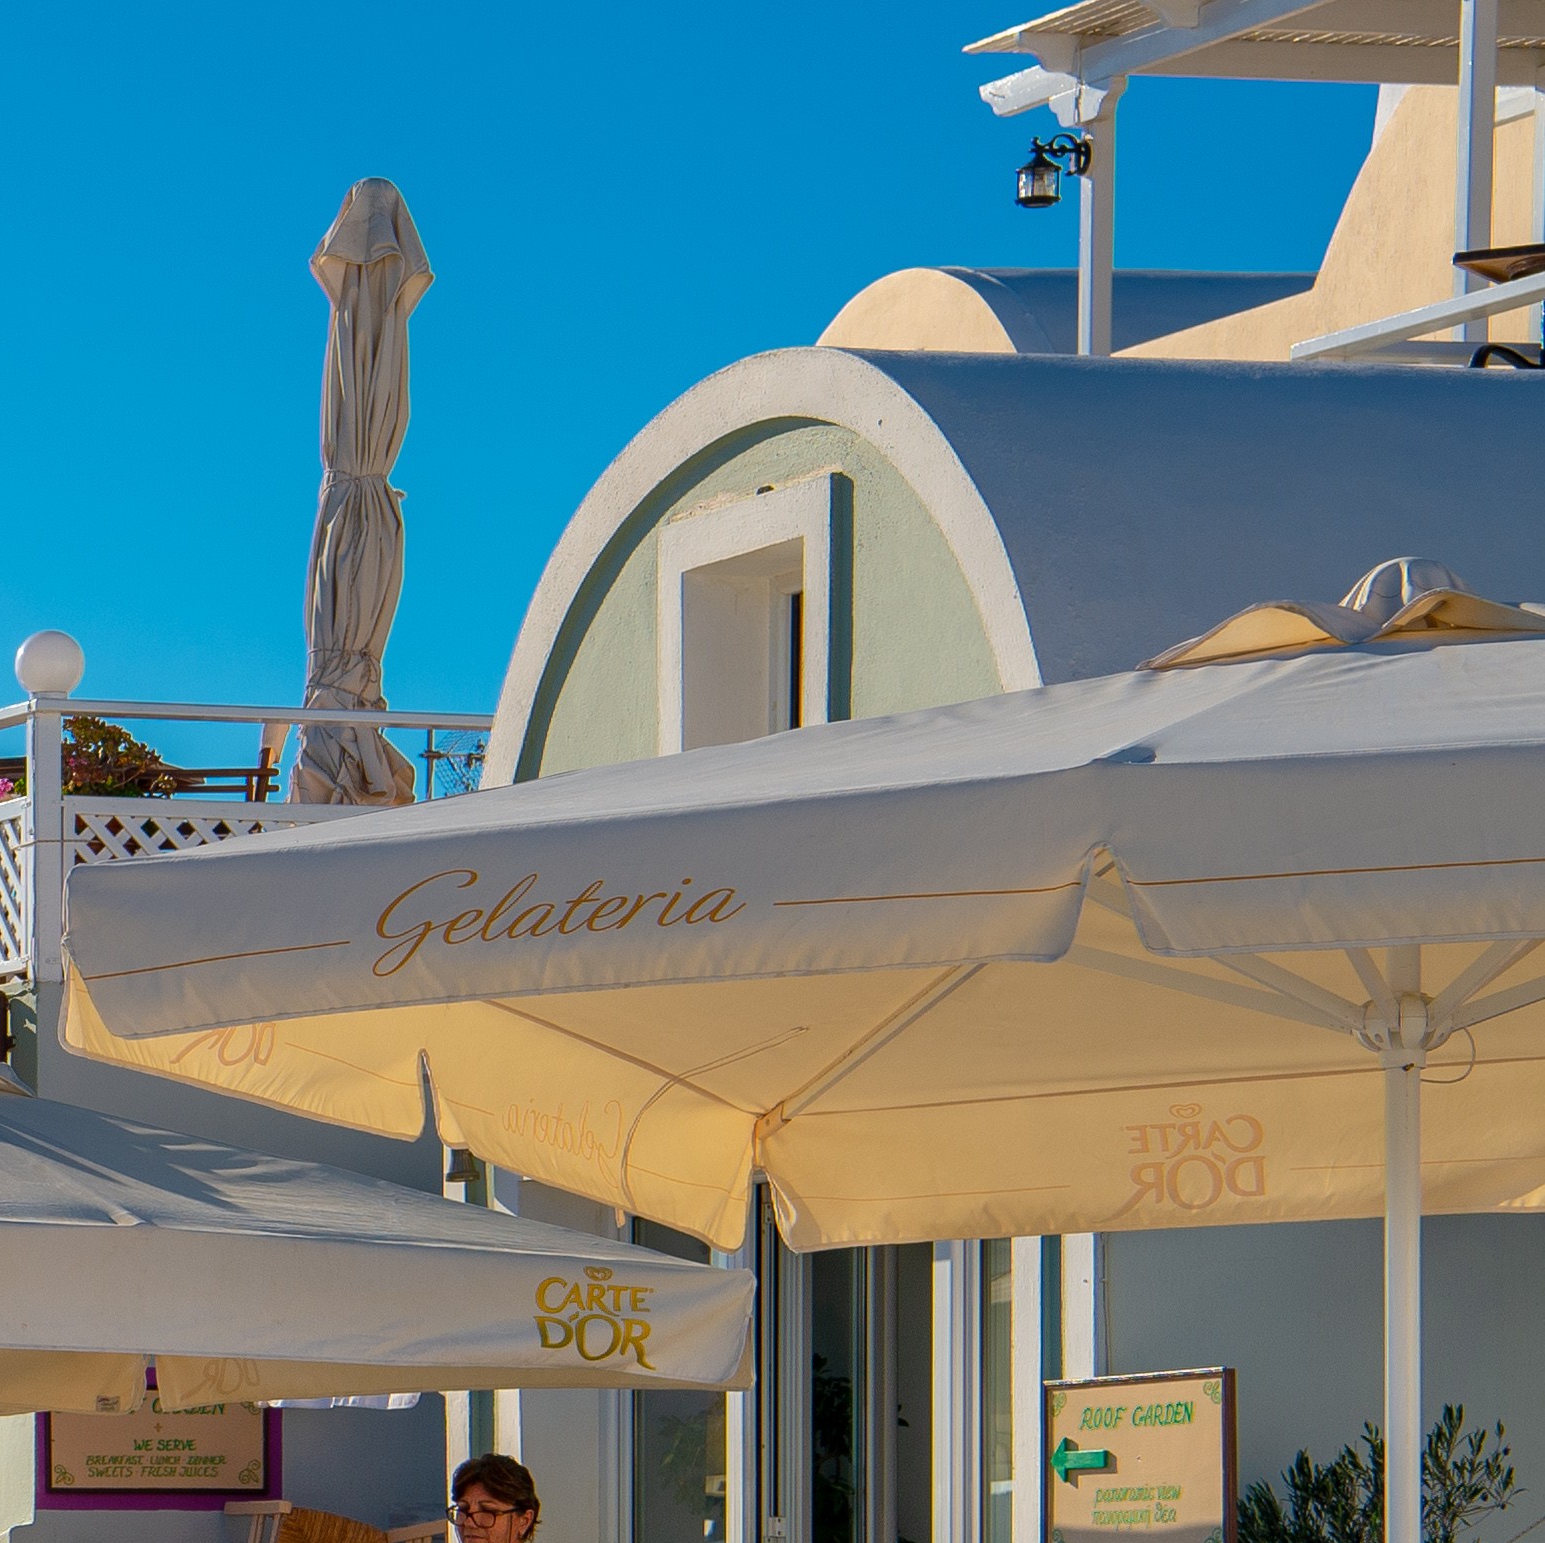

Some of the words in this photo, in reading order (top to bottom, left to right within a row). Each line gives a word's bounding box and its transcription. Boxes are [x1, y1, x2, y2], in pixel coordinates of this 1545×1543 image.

[372, 869, 746, 977] Gelateria
[535, 1276, 651, 1317] CARTE
[533, 1311, 657, 1371] D'OR
[1079, 1406, 1126, 1430] ROOF
[1131, 1401, 1195, 1428] GARDEN
[133, 1439, 153, 1451] WE
[156, 1439, 197, 1451] SERVE
[86, 1455, 144, 1465] BREAKFAST
[150, 1455, 181, 1465] LUNCH
[186, 1455, 227, 1465] DINNER
[88, 1466, 134, 1478] SWEETS
[140, 1467, 177, 1477] FRESH
[179, 1467, 219, 1477] JUICES
